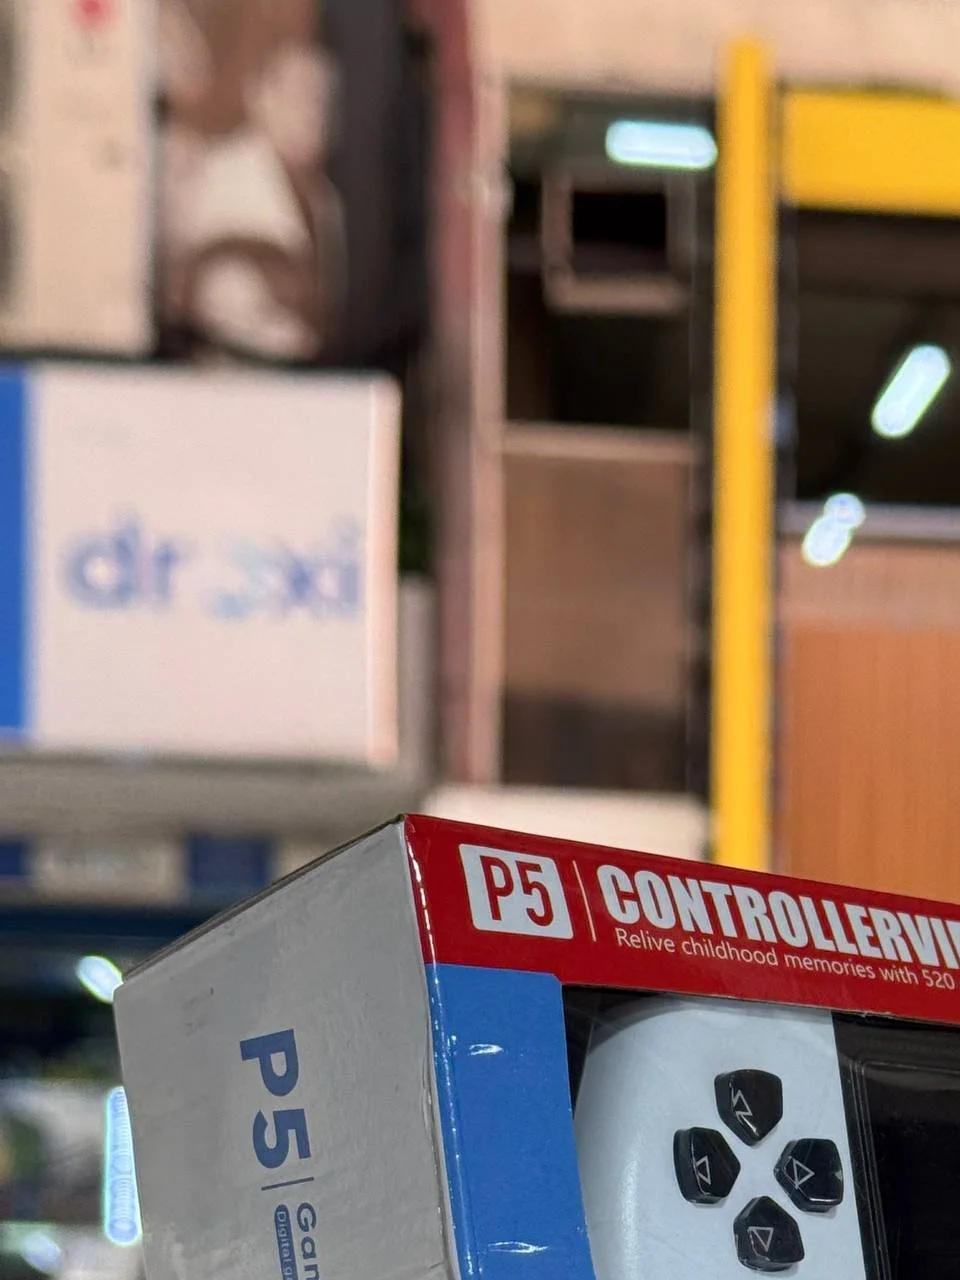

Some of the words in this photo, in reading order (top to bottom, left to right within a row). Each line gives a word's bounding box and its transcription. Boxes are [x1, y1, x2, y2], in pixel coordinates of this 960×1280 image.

[475, 852, 556, 929] P5
[614, 927, 676, 952] Relive
[681, 936, 779, 966] childhood
[784, 952, 876, 980] memories
[879, 964, 920, 986] with
[921, 969, 956, 990] 520
[240, 1028, 313, 1169] P5
